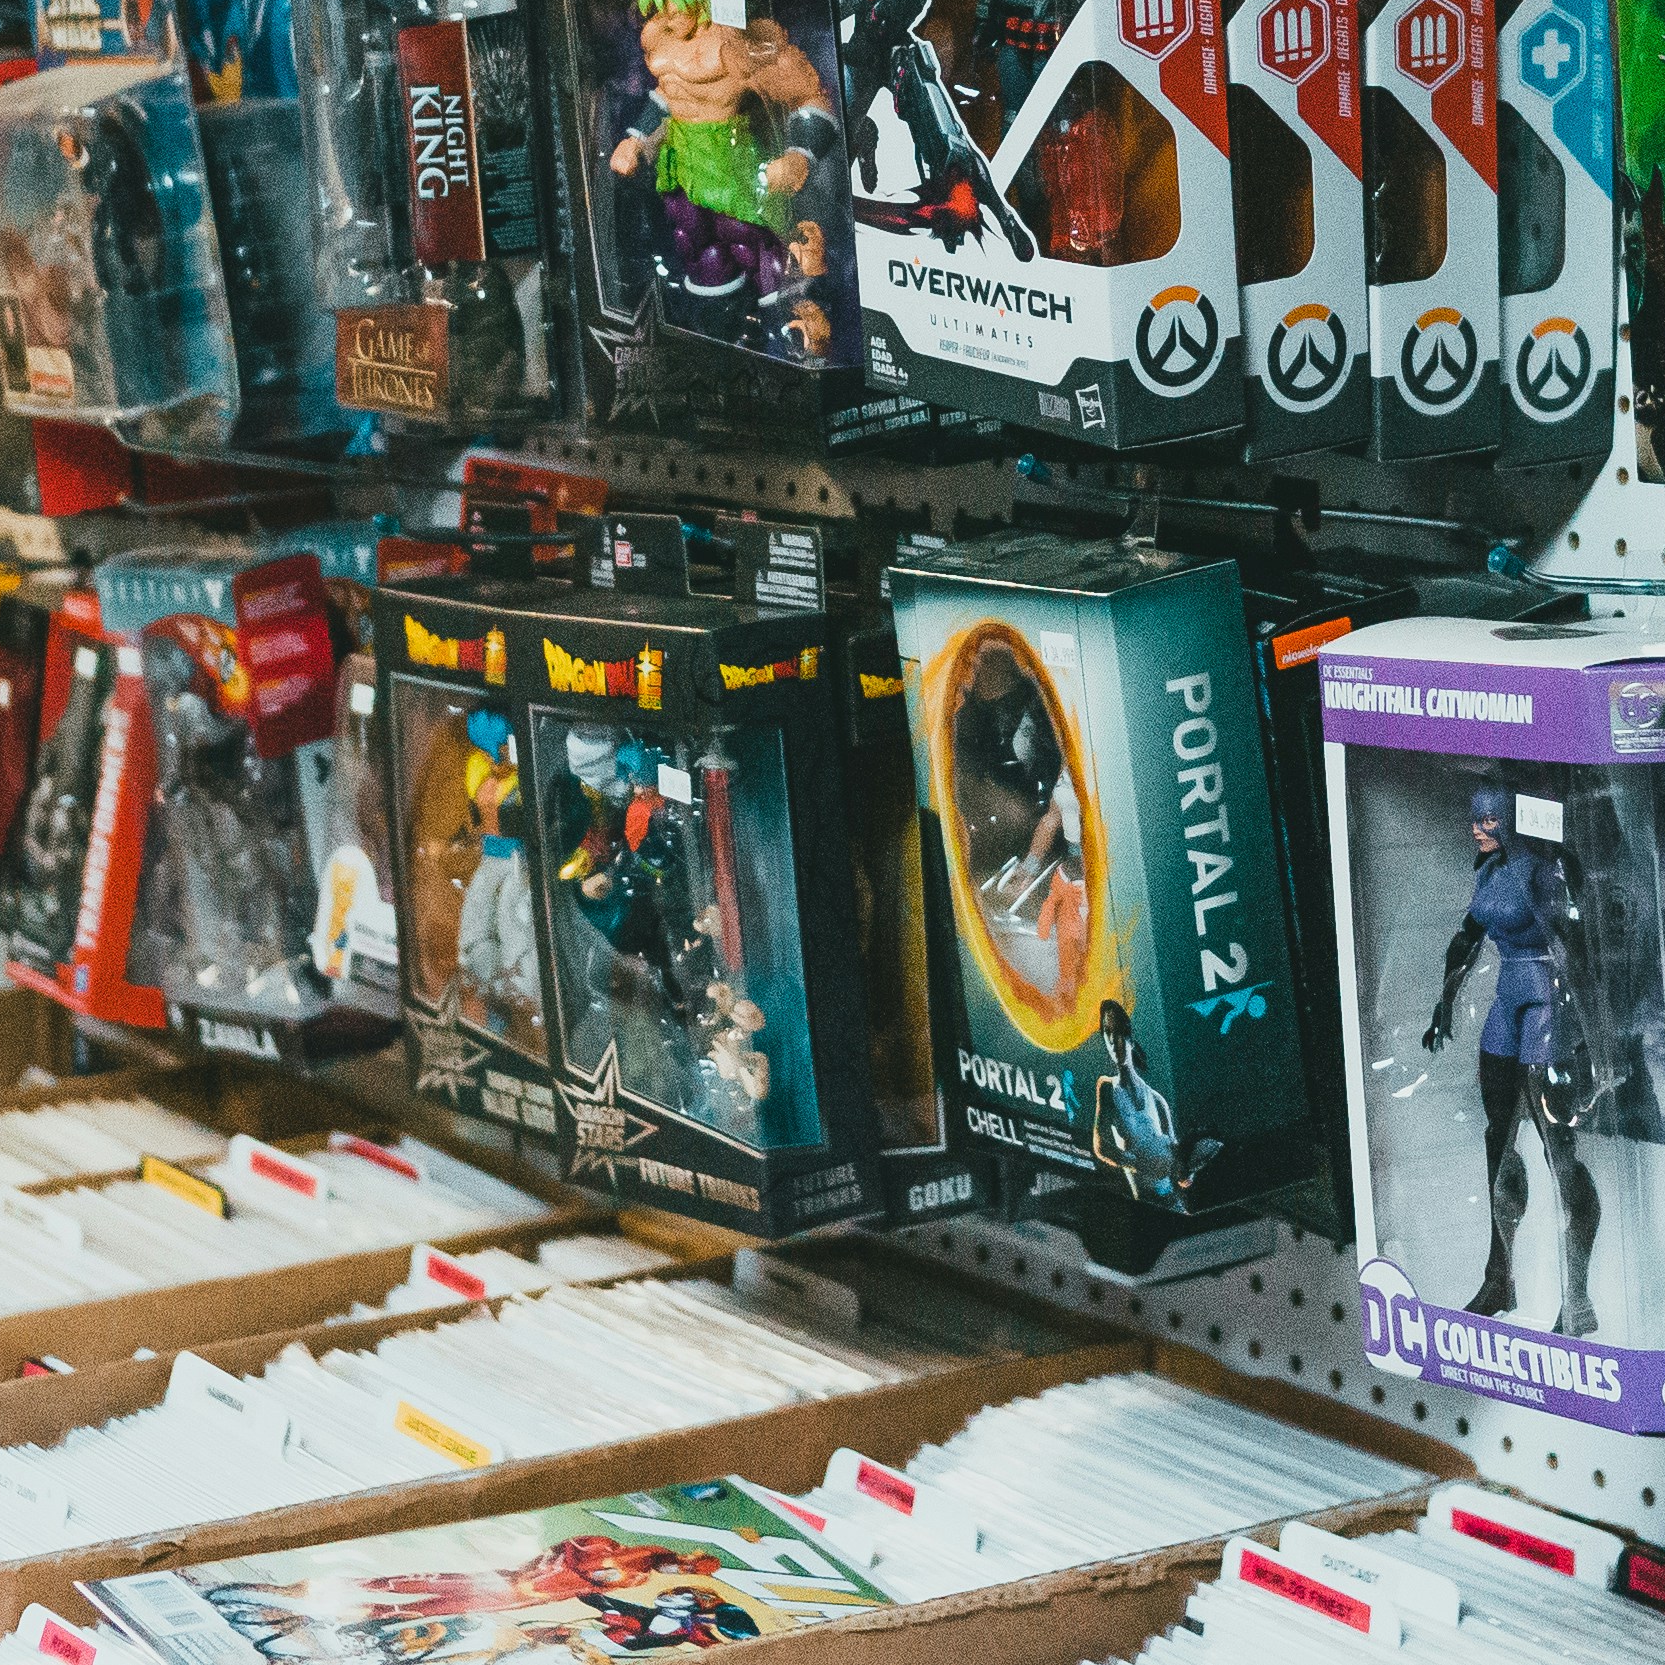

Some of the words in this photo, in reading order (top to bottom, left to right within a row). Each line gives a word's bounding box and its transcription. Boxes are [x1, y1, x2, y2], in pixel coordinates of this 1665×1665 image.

[409, 85, 449, 201] KING
[443, 94, 470, 188] NIGHT
[888, 259, 1073, 325] OVERWATCH
[353, 317, 414, 362] GAME
[929, 314, 1034, 350] ULTIMATES
[349, 364, 437, 411] THRONES
[542, 637, 606, 697] DRAGON
[718, 662, 775, 691] DRAGON
[1323, 680, 1423, 717] KNIGHTFALL
[1426, 688, 1534, 725] CATWOMAN
[1165, 670, 1241, 937] PORTAL
[1201, 944, 1250, 993] 2
[957, 1048, 1046, 1106] PORTAL
[1045, 1074, 1067, 1113] 2
[576, 1123, 626, 1151] STARS
[966, 1105, 1025, 1148] CHELL
[638, 1156, 695, 1195] FUTURE
[697, 1170, 761, 1213] TRUNKS
[907, 1172, 974, 1212] GOKU
[1359, 1282, 1429, 1369] DC
[1434, 1317, 1622, 1404] COLLECTIBLES
[1320, 1553, 1381, 1584] OUTCAST
[1307, 1586, 1355, 1620] FINEST
